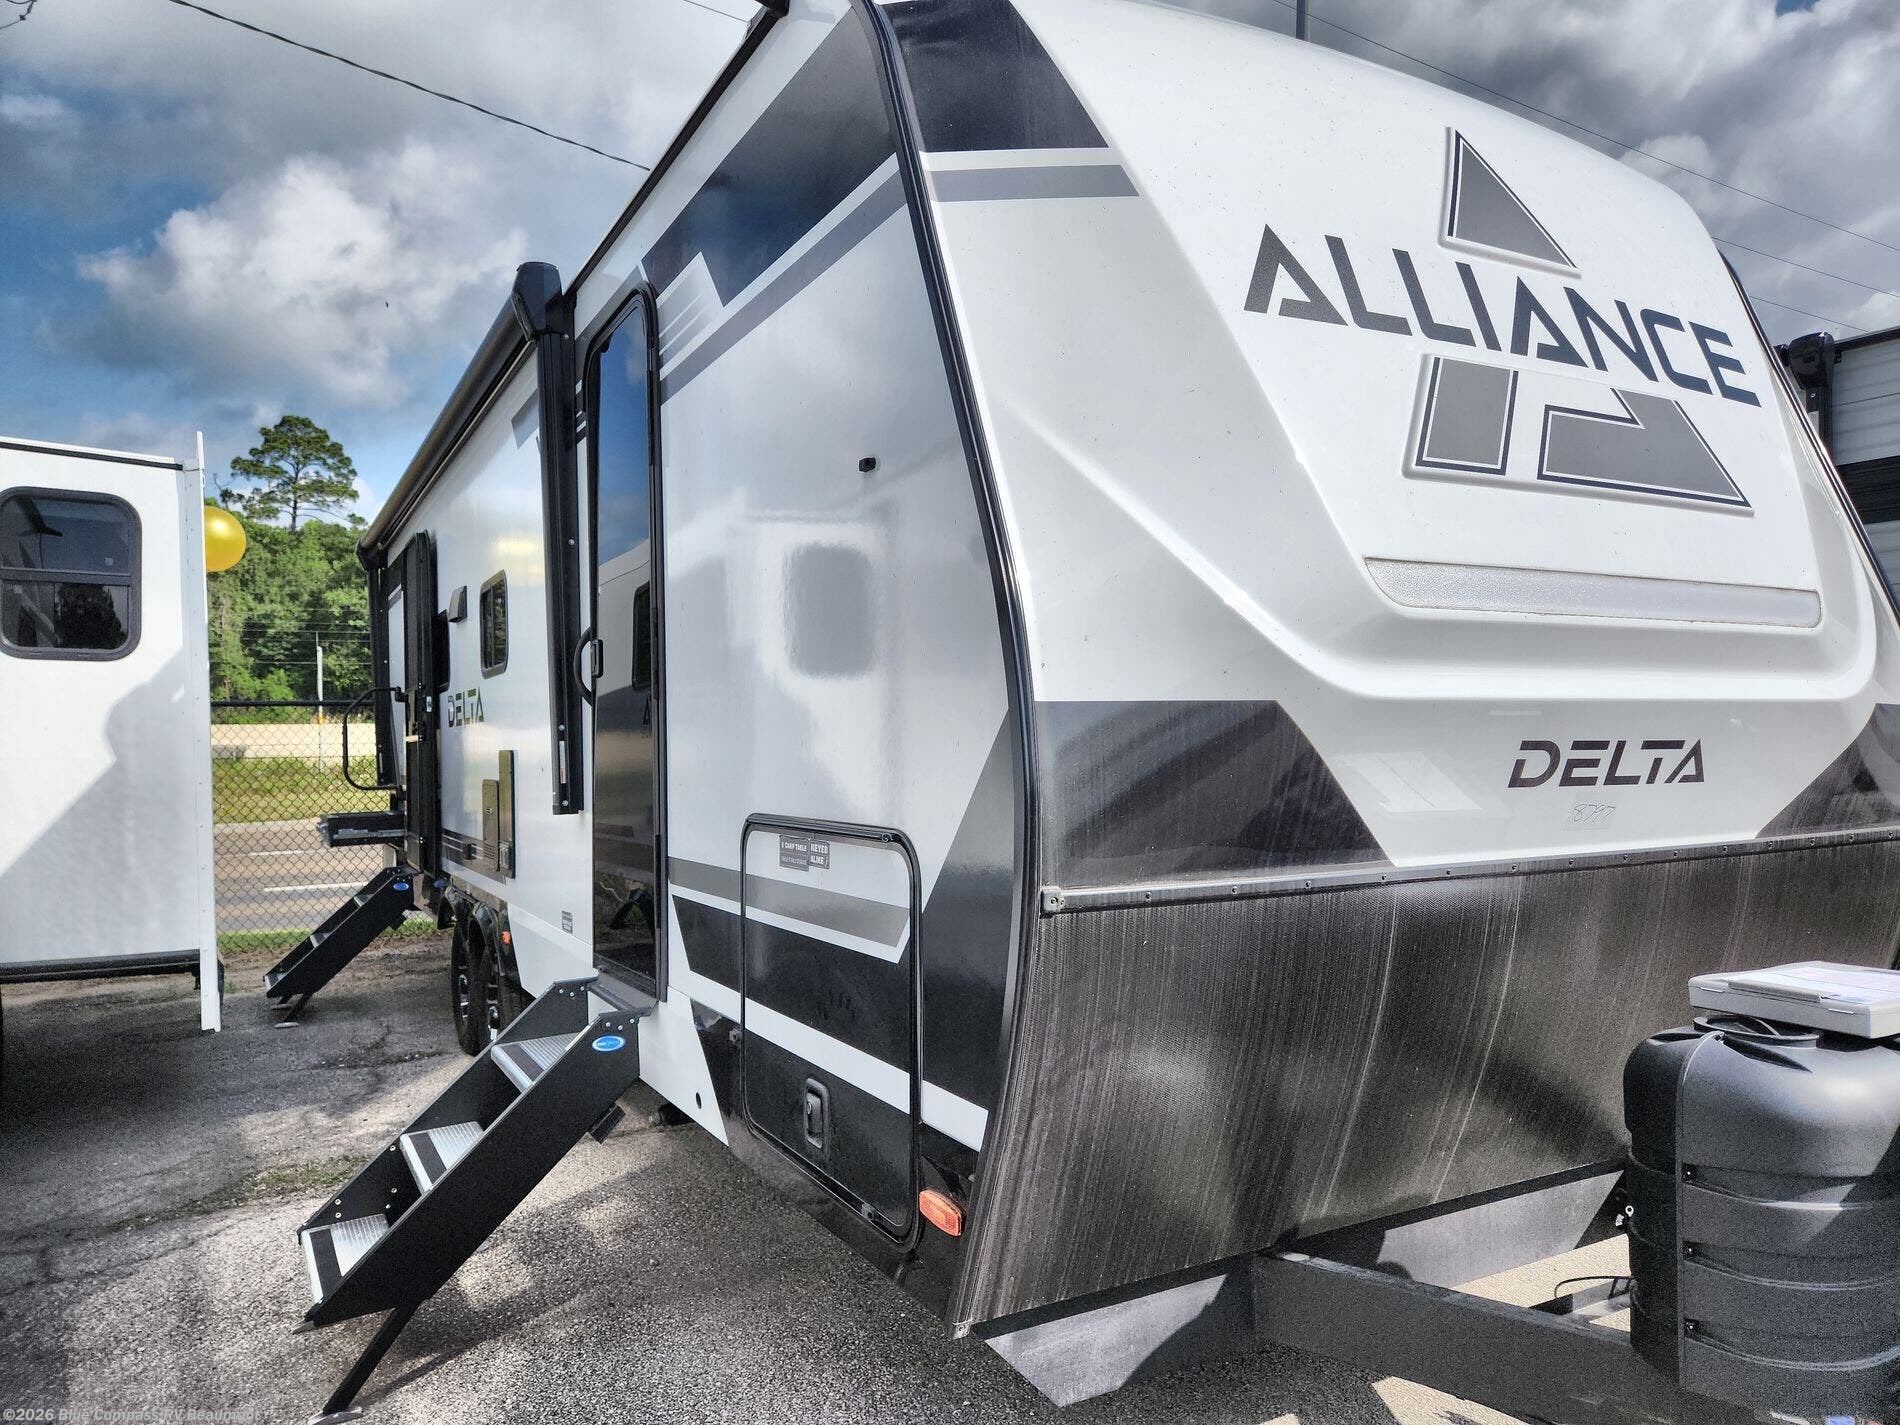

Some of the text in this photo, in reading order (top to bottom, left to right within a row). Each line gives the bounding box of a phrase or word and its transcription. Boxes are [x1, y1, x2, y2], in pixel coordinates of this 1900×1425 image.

[1243, 223, 1762, 408] ALLIANCE
[448, 686, 485, 728] DELTA
[1507, 738, 1705, 788] DELTA
[810, 843, 829, 854] KEYED
[810, 855, 824, 865] ALIKE
